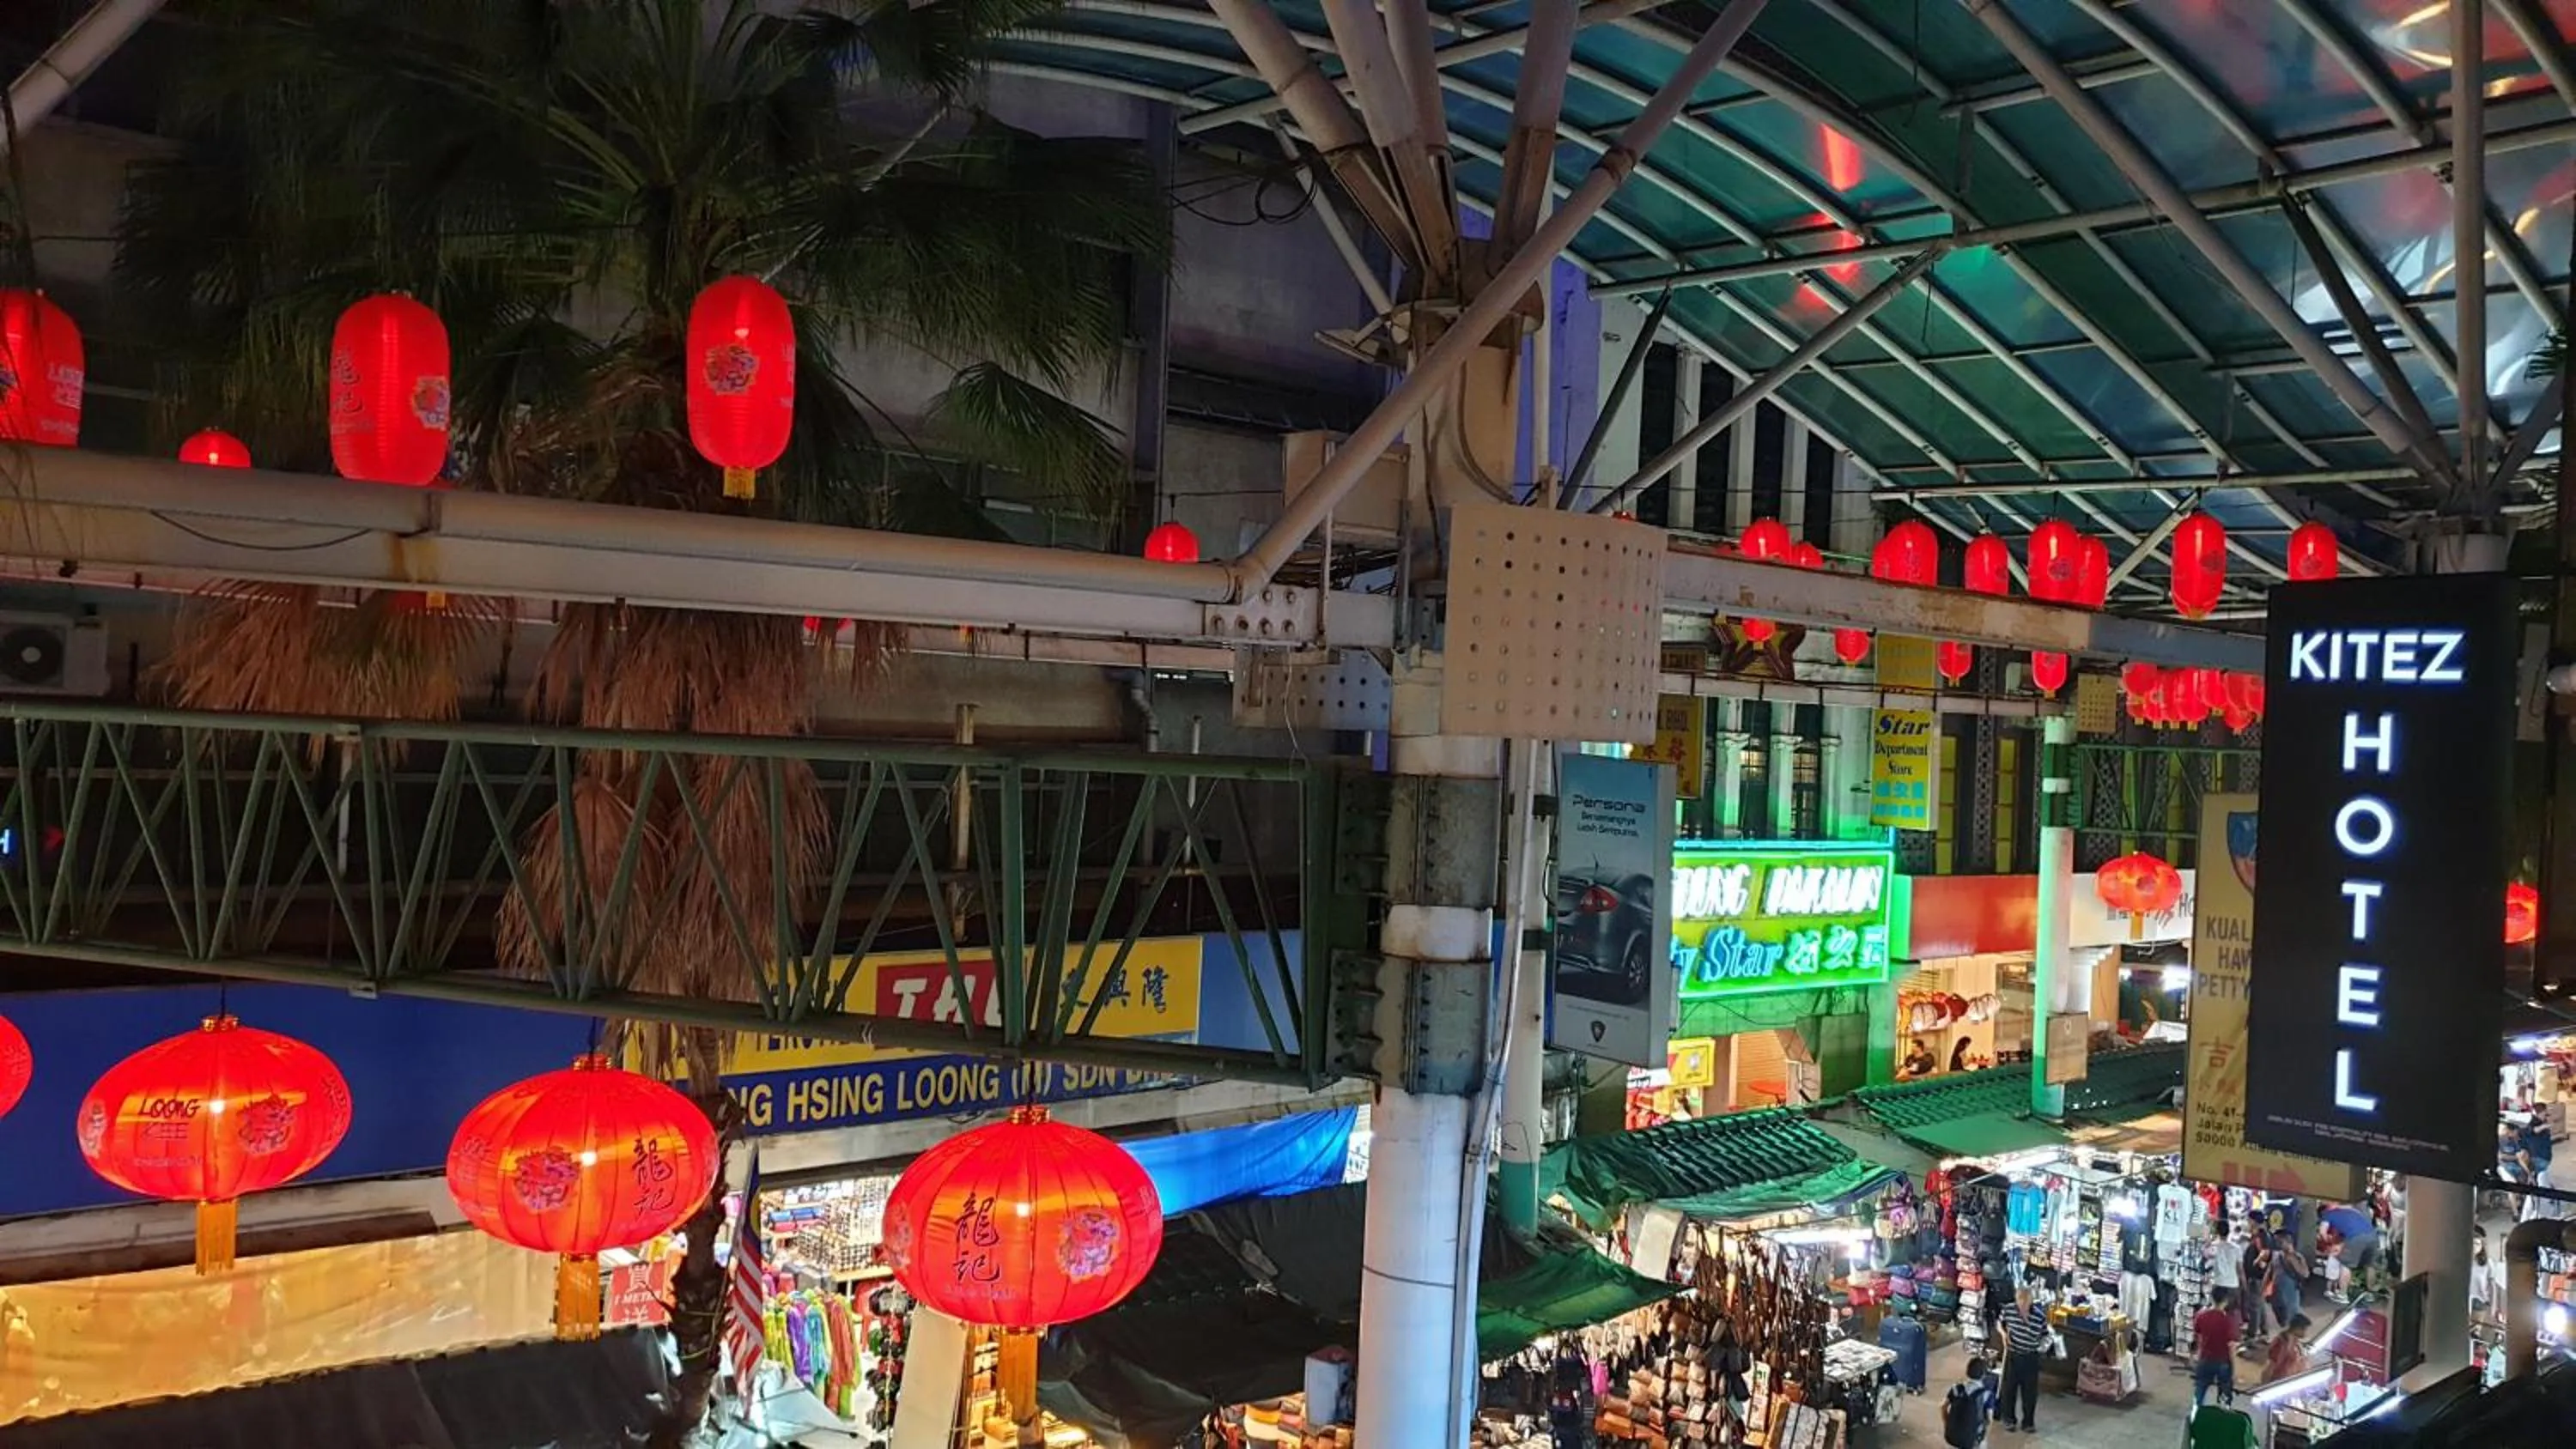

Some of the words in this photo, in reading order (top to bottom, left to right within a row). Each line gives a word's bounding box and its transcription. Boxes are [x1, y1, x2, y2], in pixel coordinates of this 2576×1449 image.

[2290, 631, 2464, 681] KITEZ
[1875, 714, 1931, 736] Star
[1572, 793, 1646, 814] Persona
[2206, 916, 2250, 942] KUAL
[2335, 713, 2394, 1113] HOTEL
[1703, 925, 1783, 982] Star
[138, 1097, 200, 1119] LOONG
[787, 1073, 884, 1124] HSING
[896, 1062, 999, 1112] LOONG
[2196, 1118, 2232, 1134] Jalan
[953, 1191, 999, 1282] 龍記
